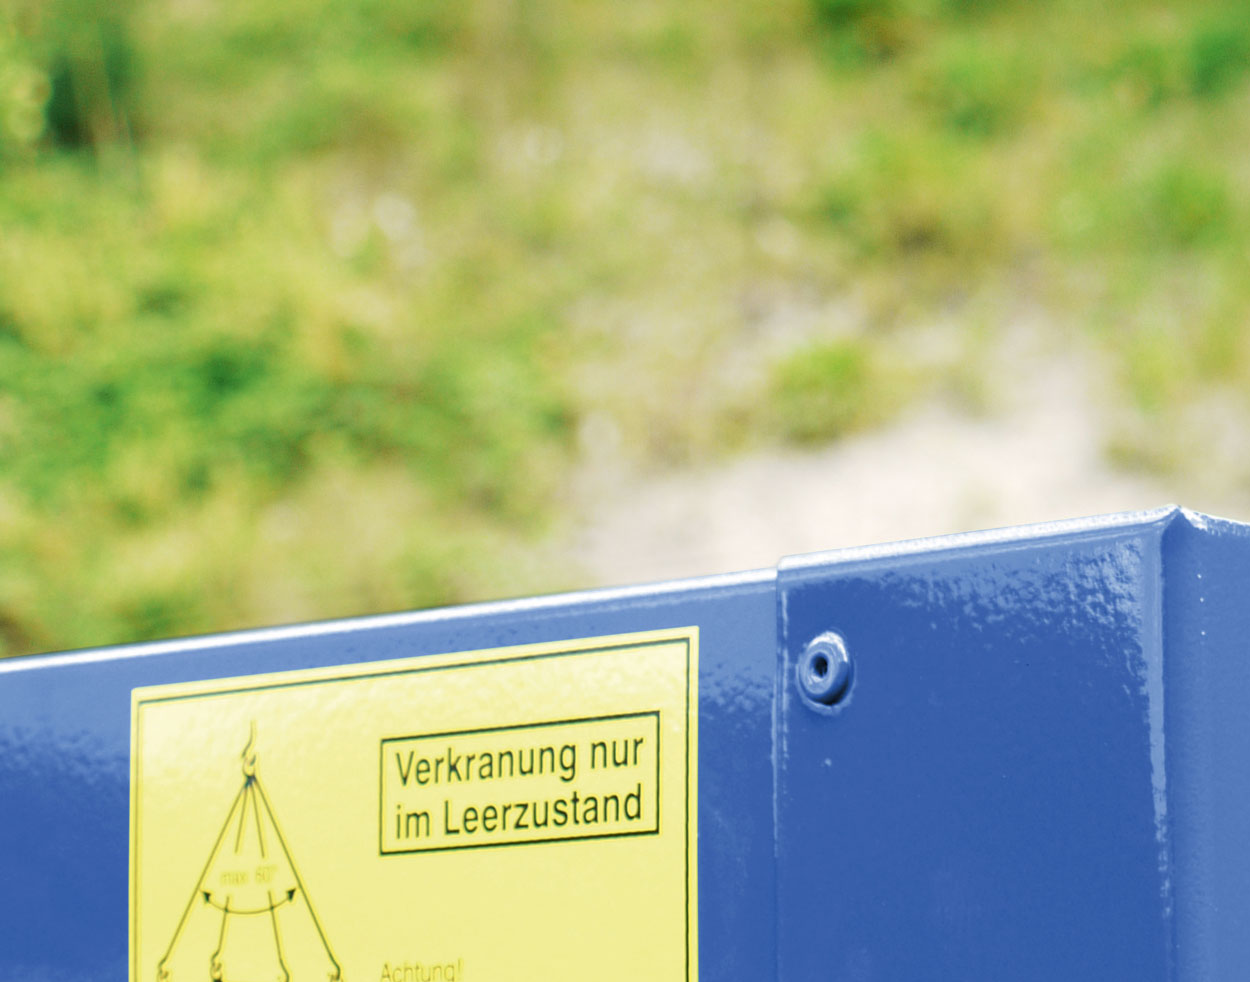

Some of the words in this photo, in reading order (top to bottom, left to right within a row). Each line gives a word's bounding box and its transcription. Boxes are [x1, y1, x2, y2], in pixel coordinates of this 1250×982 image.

[396, 744, 577, 786] Verkranung
[591, 737, 644, 769] nur
[396, 804, 431, 839] im
[444, 782, 642, 836] Leerzustand
